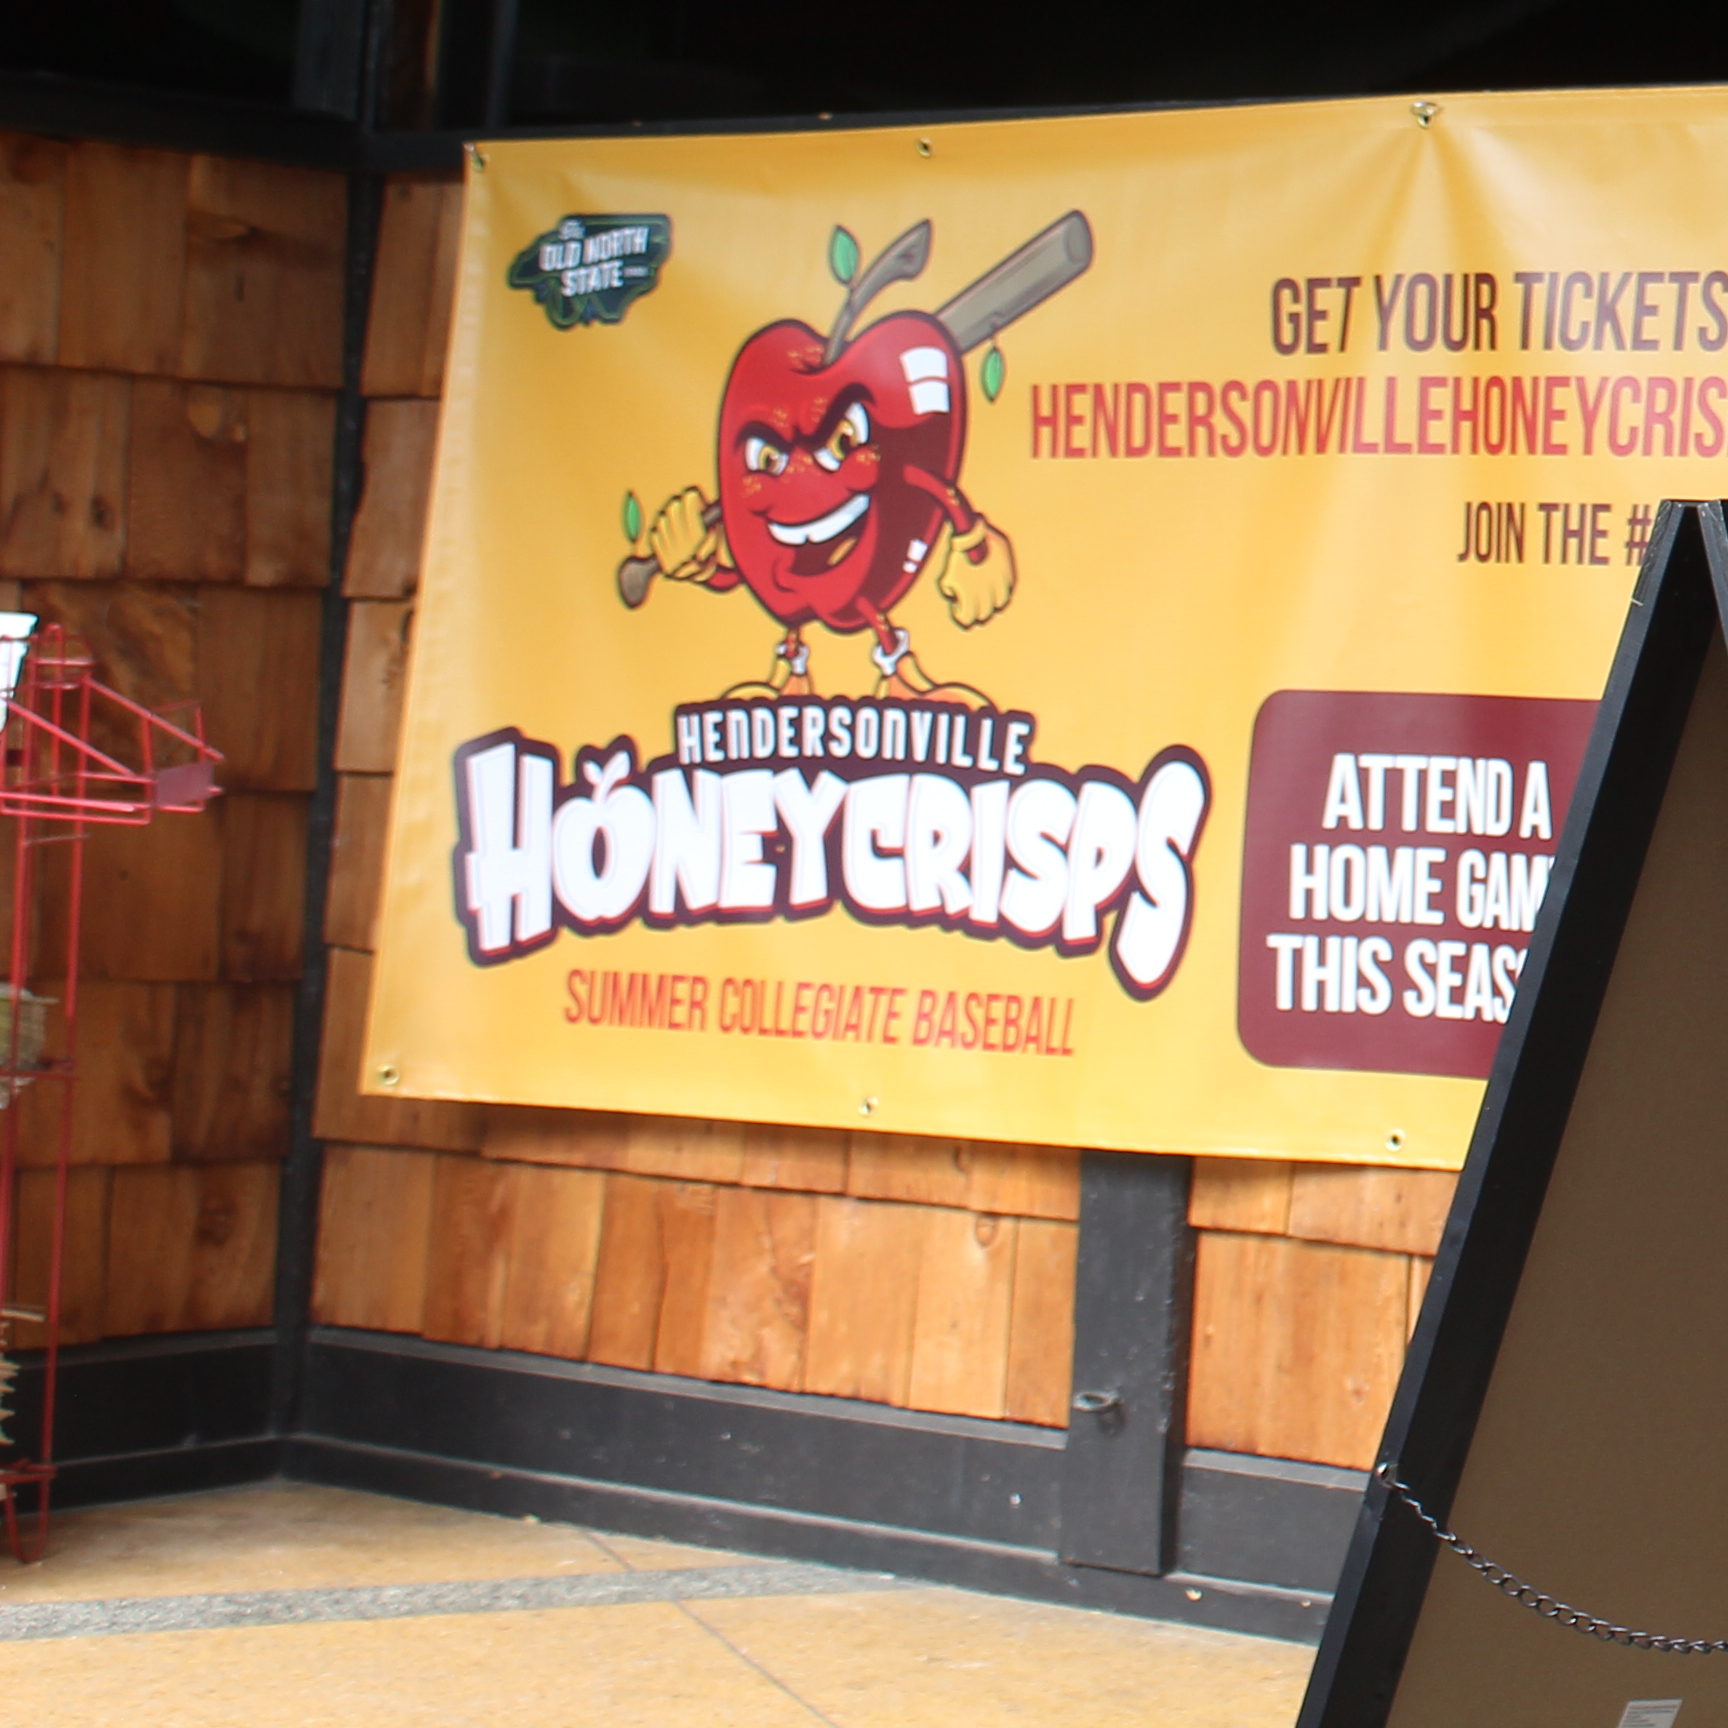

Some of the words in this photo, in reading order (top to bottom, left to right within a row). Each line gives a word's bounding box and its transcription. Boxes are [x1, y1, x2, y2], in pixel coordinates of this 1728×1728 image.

[538, 240, 583, 272] OLD
[582, 225, 650, 265] NORTH
[560, 260, 625, 297] STATE
[1270, 276, 1360, 355] GET
[1374, 273, 1498, 353] YOUR
[1456, 501, 1526, 565] JOIN
[1538, 502, 1611, 566] THE
[677, 705, 1034, 776] HENDERSONVILLE
[1321, 752, 1514, 837] ATTEND
[1518, 760, 1554, 840] A
[463, 740, 1206, 989] HONEYCRISPS
[1288, 842, 1447, 925] HOME
[1455, 849, 1557, 933] GAM
[564, 968, 709, 1034] SUMMER
[720, 978, 903, 1046] COLLEGIATE
[912, 988, 1077, 1057] BASEBALL
[1266, 932, 1394, 1016] THIS
[1402, 937, 1530, 1024] SEAS
